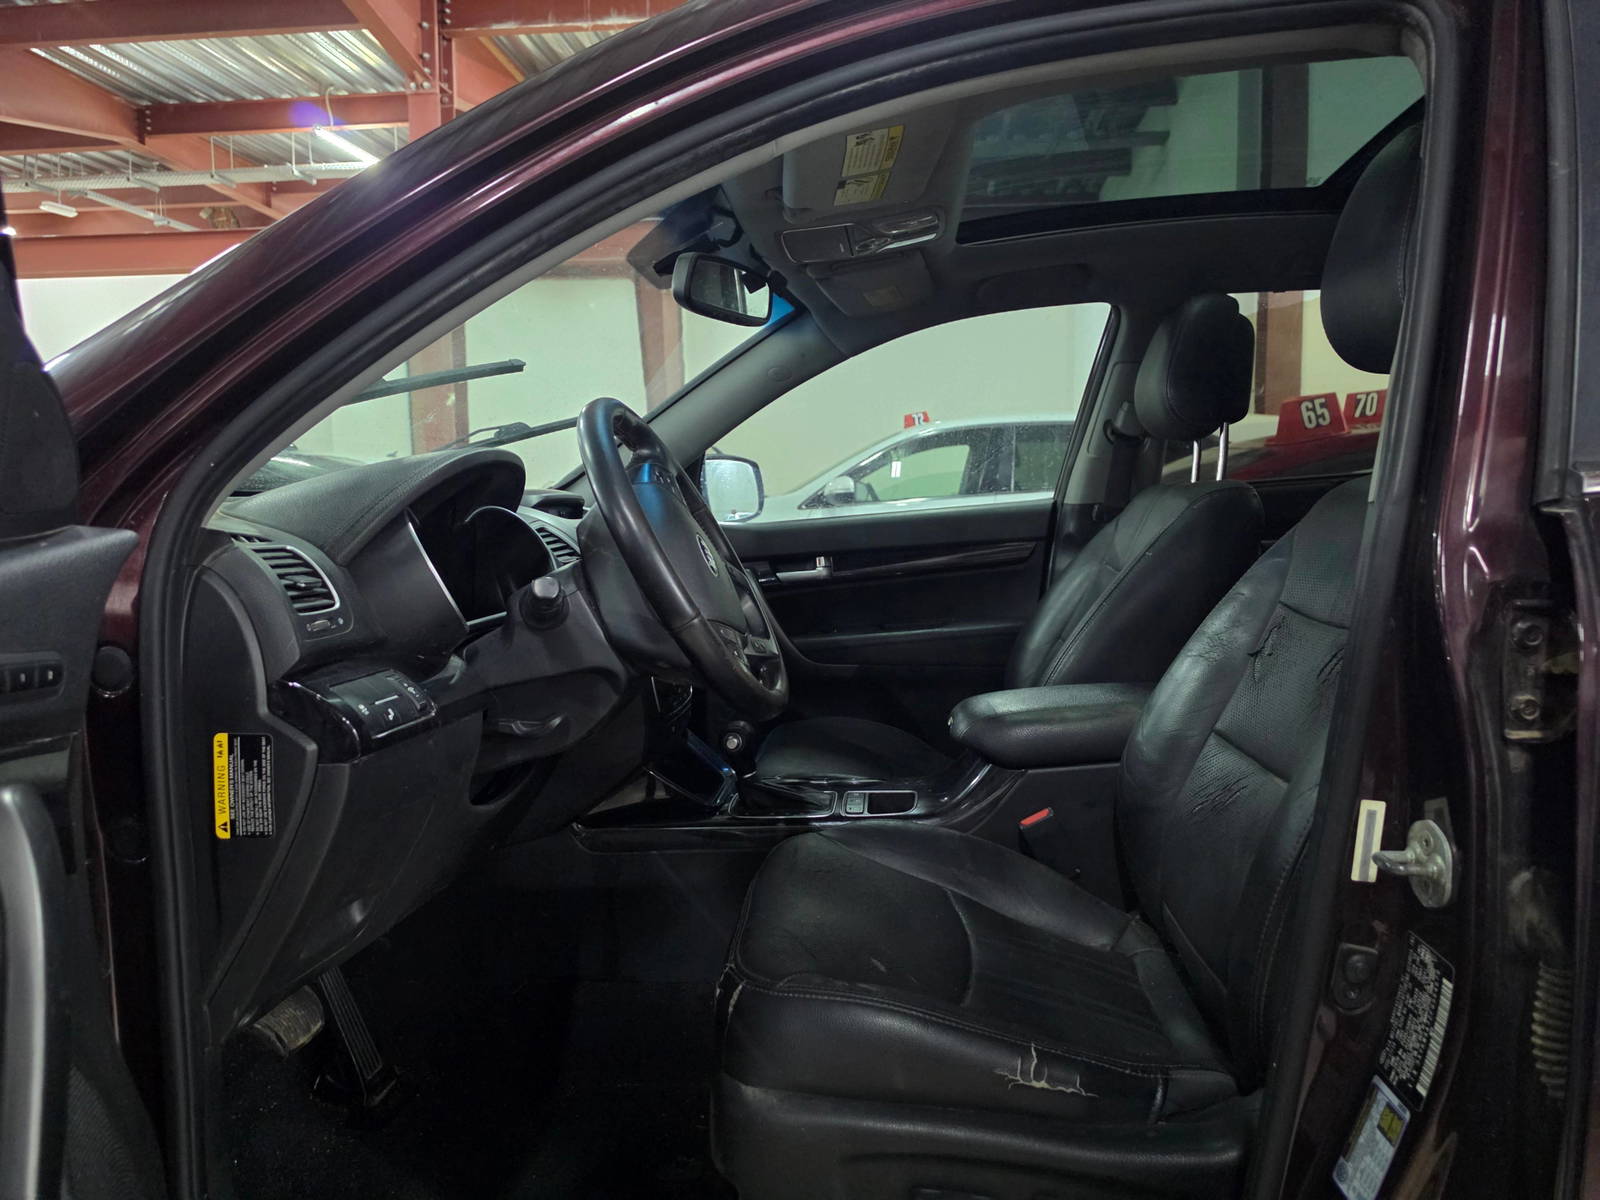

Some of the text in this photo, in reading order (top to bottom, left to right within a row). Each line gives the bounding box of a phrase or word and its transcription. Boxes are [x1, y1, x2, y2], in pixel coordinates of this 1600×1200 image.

[1300, 398, 1331, 429] 65
[1354, 392, 1378, 418] 70
[217, 765, 226, 815] WARNING
